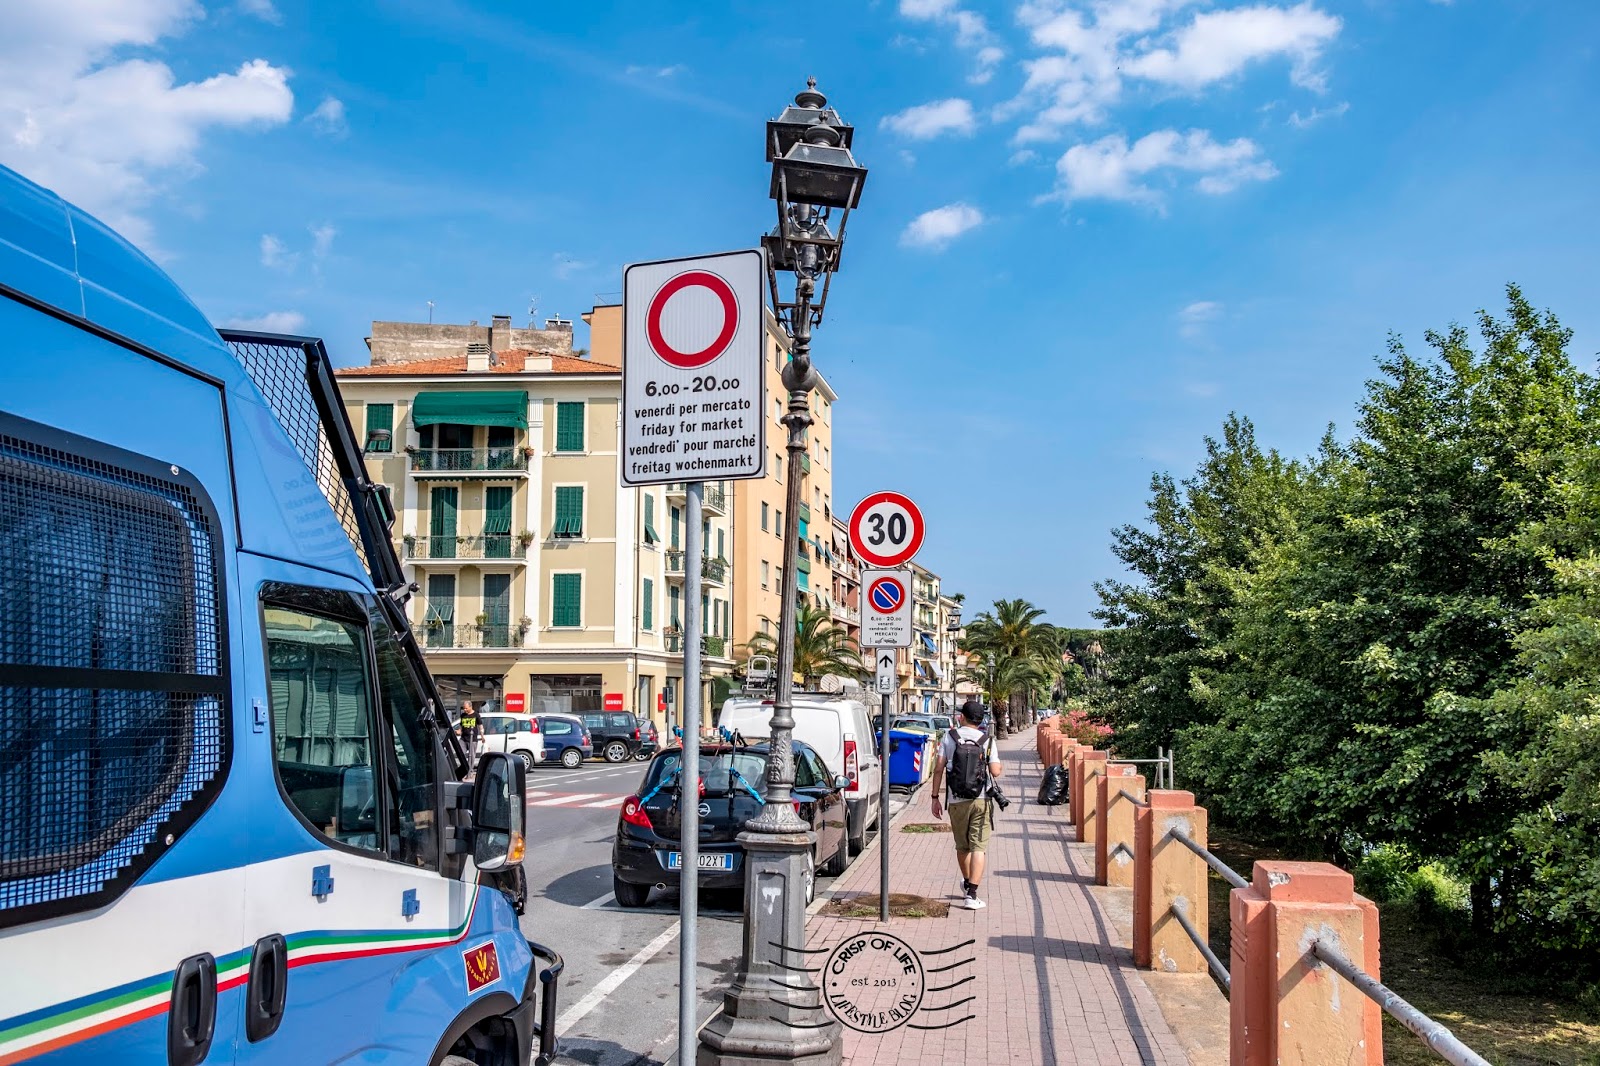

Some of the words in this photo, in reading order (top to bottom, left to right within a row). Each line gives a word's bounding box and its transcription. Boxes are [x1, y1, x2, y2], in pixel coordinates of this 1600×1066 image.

[635, 403, 675, 418] venerdi
[679, 404, 698, 417] per
[702, 398, 751, 413] mercato
[641, 423, 675, 437] friday
[680, 421, 697, 433] for
[701, 417, 744, 432] market
[684, 440, 709, 454] pour
[632, 462, 671, 475] freitag
[675, 454, 753, 471] wochenmarkt
[867, 512, 907, 546] 30
